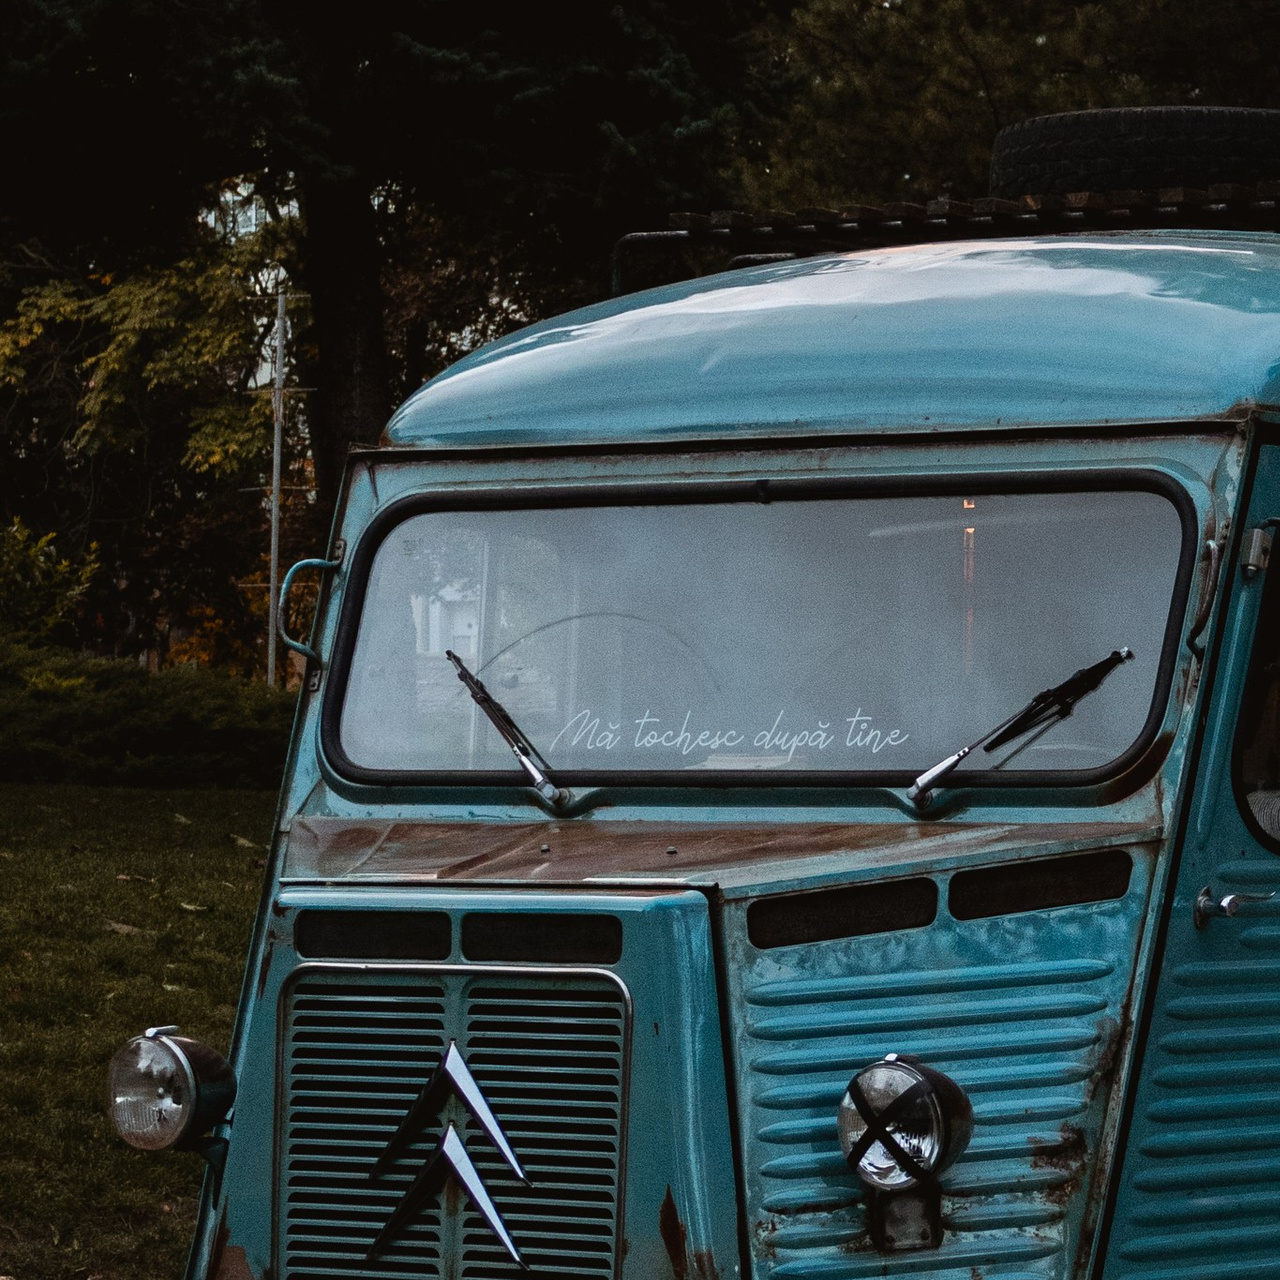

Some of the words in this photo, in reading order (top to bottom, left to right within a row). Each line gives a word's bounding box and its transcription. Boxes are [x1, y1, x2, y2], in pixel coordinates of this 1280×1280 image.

[549, 709, 621, 753] Mă
[634, 709, 746, 755] tochesc
[753, 709, 836, 762] după
[845, 707, 910, 754] tine
